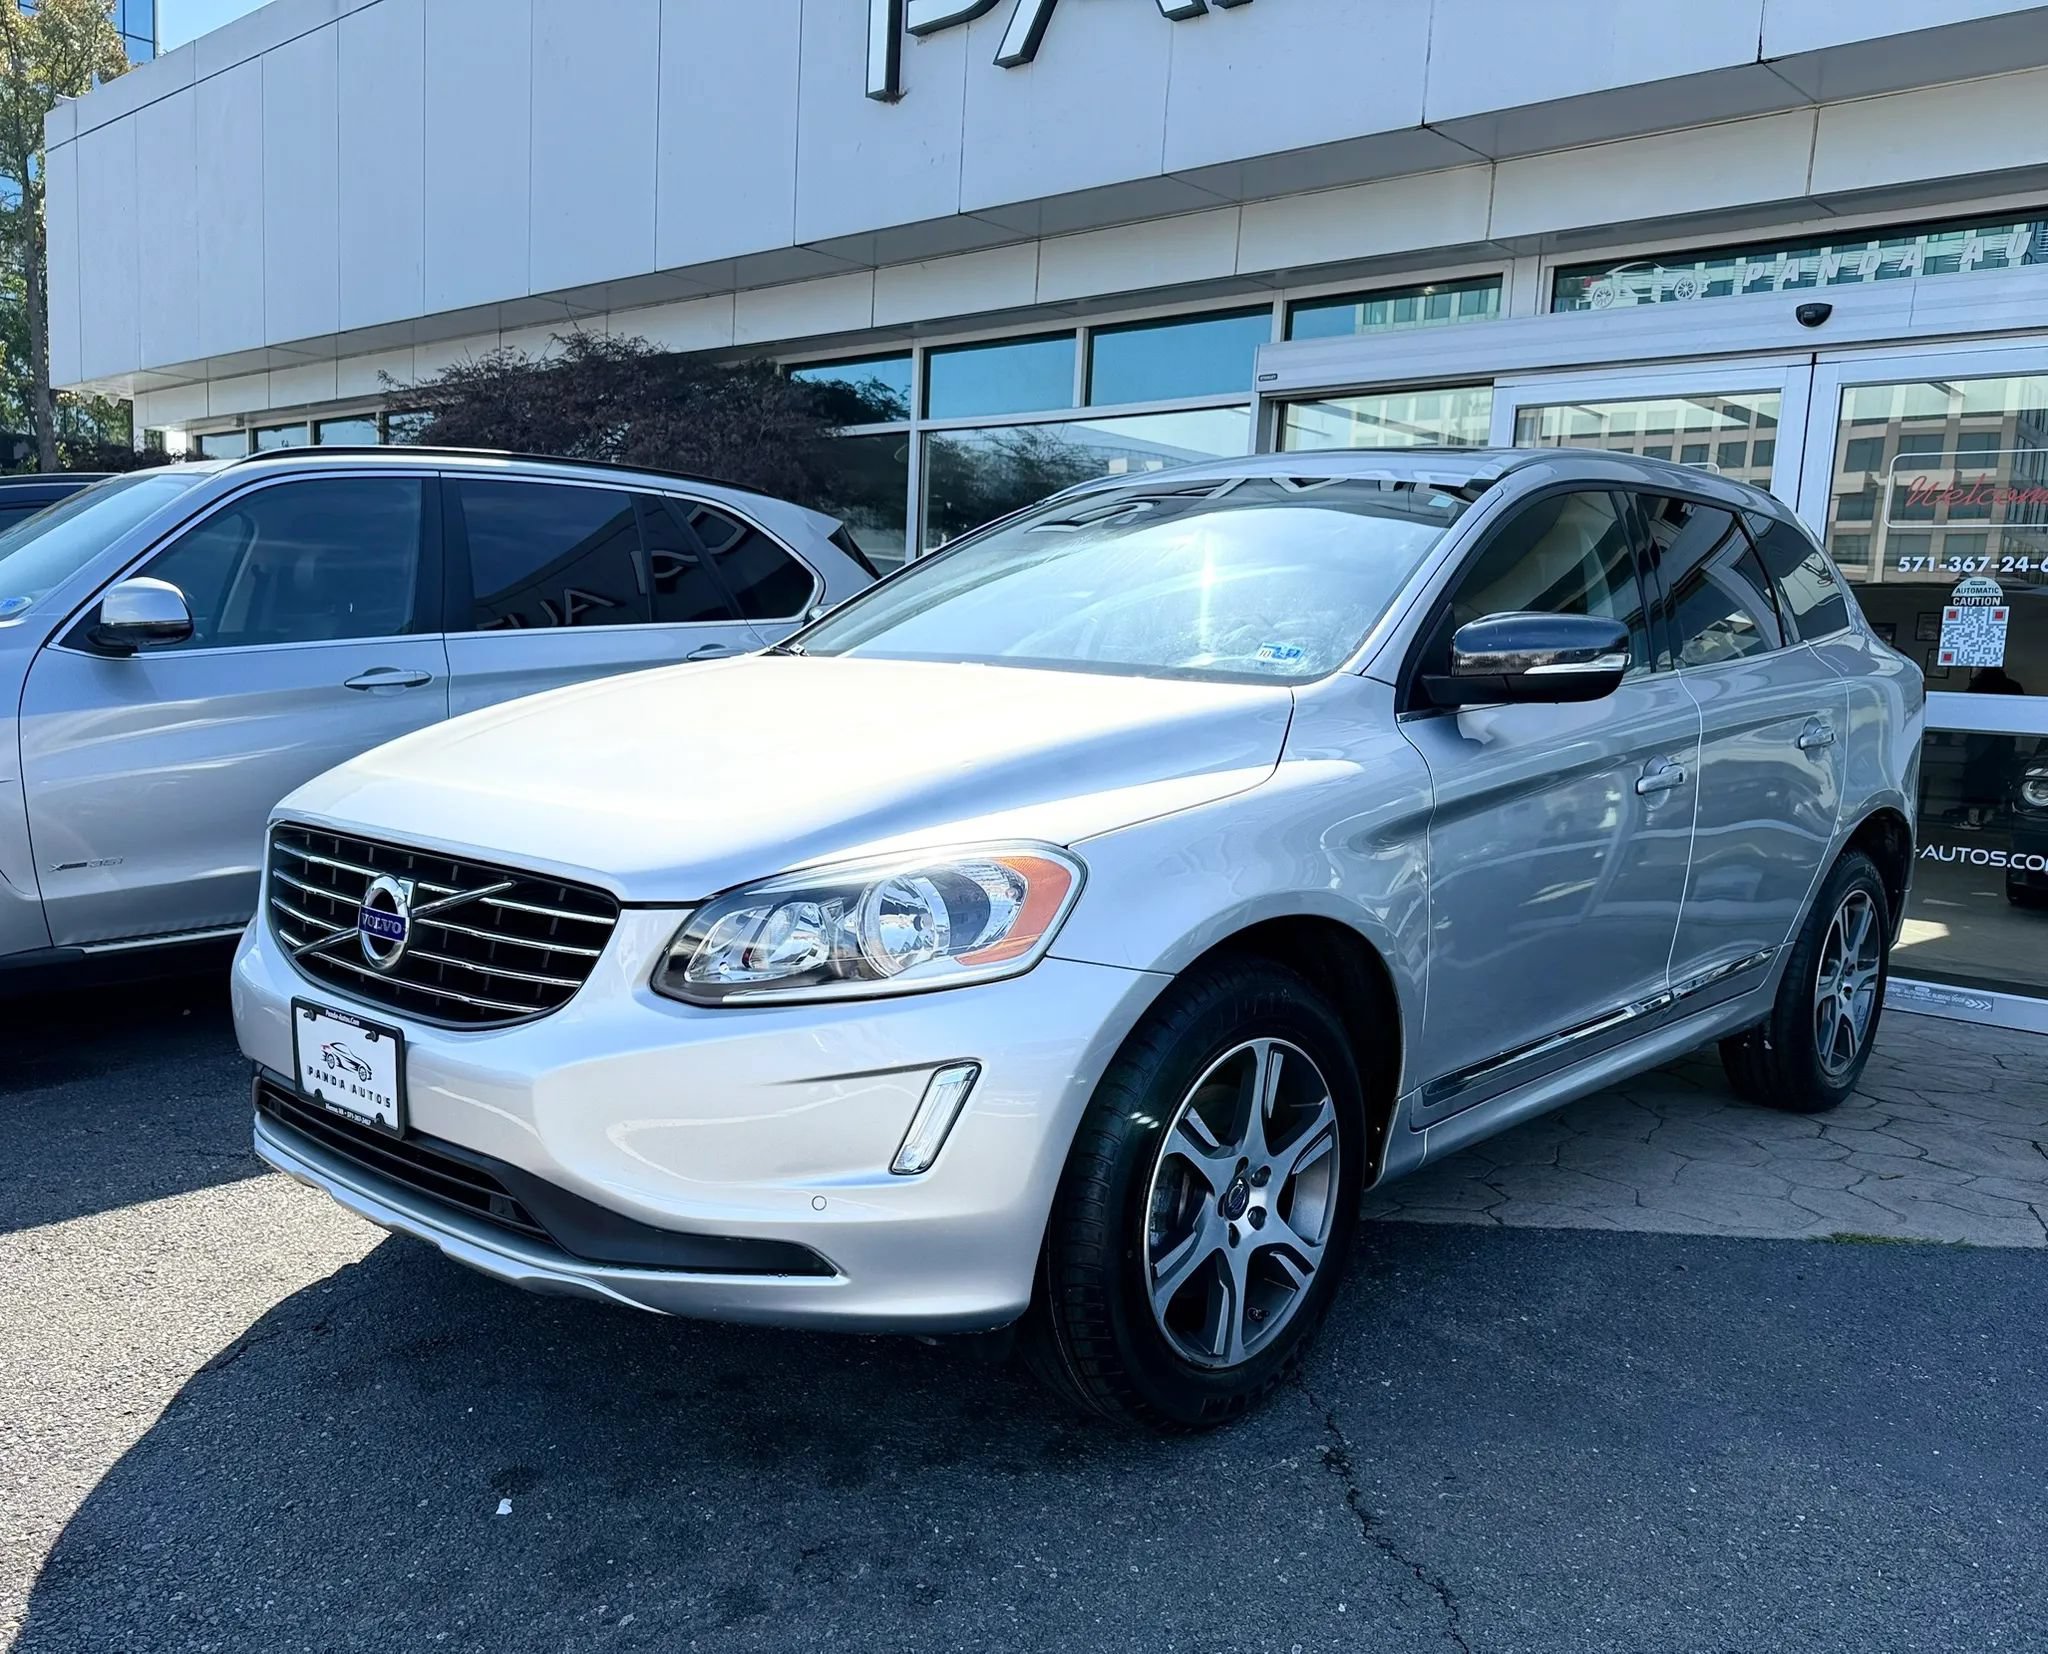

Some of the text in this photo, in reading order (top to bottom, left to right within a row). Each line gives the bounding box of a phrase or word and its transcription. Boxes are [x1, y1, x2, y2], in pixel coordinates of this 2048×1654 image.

[1742, 244, 1924, 287] PANDA
[1952, 596, 2001, 606] CAUTION
[1955, 586, 2000, 595] AUTOMATIC
[1915, 844, 2048, 871] -AUTOS.CO
[360, 911, 402, 935] VOLVO
[307, 1065, 391, 1108] PANDA AUTOS
